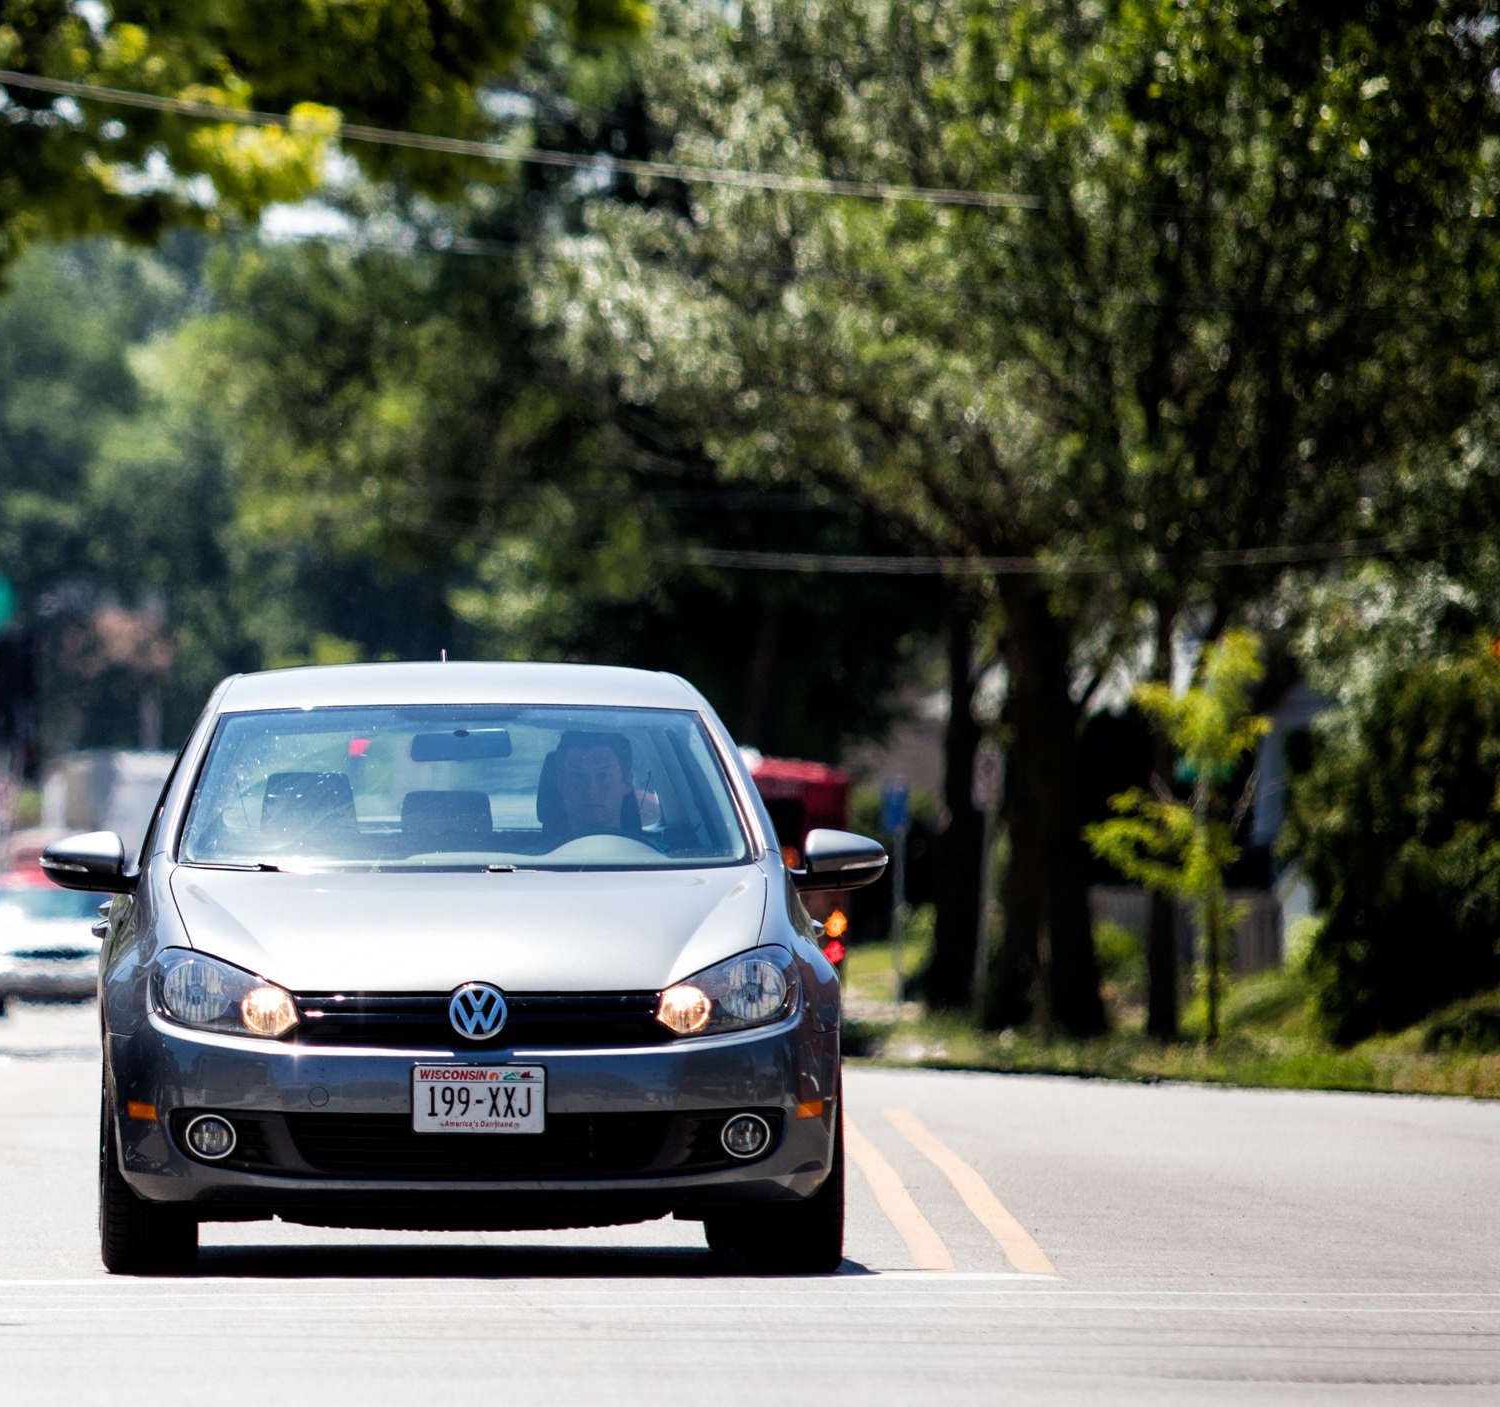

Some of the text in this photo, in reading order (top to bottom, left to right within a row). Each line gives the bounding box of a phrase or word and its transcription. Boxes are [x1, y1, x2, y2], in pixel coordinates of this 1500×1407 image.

[452, 987, 505, 1037] VW
[420, 1069, 488, 1080] WISCONSIN
[427, 1086, 531, 1118] 199-XXJ
[444, 1120, 513, 1129] America's Dairyland
